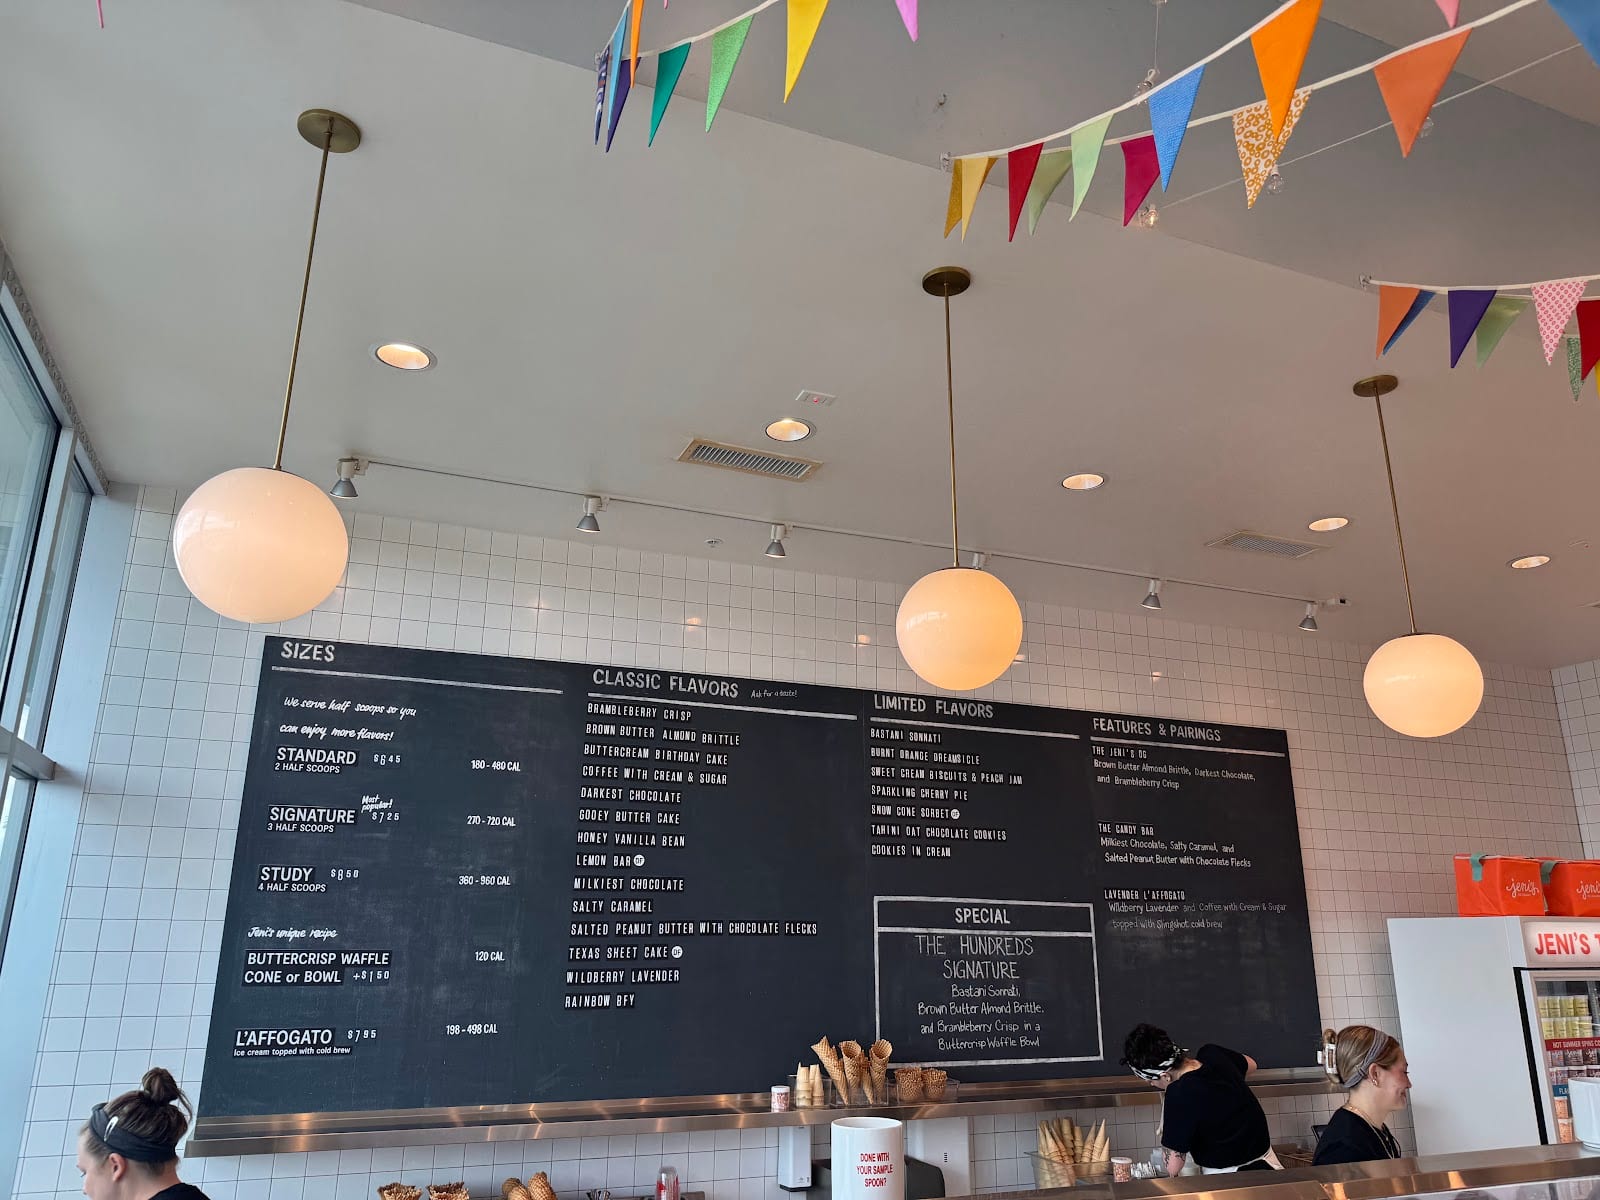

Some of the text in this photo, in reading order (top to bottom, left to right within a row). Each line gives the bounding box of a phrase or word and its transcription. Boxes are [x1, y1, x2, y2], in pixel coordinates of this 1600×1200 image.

[280, 642, 335, 662] SIZES
[592, 669, 739, 698] CLASSIC FLAVORS
[284, 697, 416, 720] We serve half scoops so you
[587, 703, 691, 721] BRAMBLEBERRY CRISP
[874, 694, 994, 719] LIMITED FLAVORS
[280, 723, 393, 741] can enjoy more flavors!
[585, 724, 740, 746] BROWN BUTTER ALMOND BRITTLE
[870, 728, 941, 743] BASTANI SONNATI
[1093, 717, 1221, 742] FEATURES & PAIRINGS
[277, 748, 357, 765] STANDARD
[584, 744, 728, 765] BUTTERCREAM BIRTHDAY CAKE
[871, 747, 980, 764] BURNT ORANGE DREAMSICLE
[1092, 746, 1147, 758] THE JENI'S OG
[275, 763, 340, 774] 2 HALF SCOOPS
[471, 760, 521, 772] 180 480 CAL
[582, 765, 727, 785] COFFEE WITH CREAM & SUGAR
[871, 767, 1022, 785] SWEET CREAM BISCUITS & PEACH JAM
[1097, 775, 1179, 790] and Brambleberry Crisp
[361, 794, 380, 804] Most
[581, 787, 681, 803] DARKEST CHOCOLATE
[871, 785, 968, 800] SPARKLING CHERRY PIE
[361, 799, 393, 813] popular!
[871, 804, 950, 819] SNOW CONE SORBET
[269, 807, 355, 823] SIGNATURE
[579, 809, 680, 824] GOOEY BUTTER CAKE
[871, 825, 1007, 841] TAHINI OAT CHOCOLATE COOKIES
[1098, 823, 1153, 836] THE CANDY BAR
[577, 832, 685, 847] HONEY VANILLA BEAN
[871, 844, 951, 857] COOKIES IN CREAM
[576, 854, 631, 867] LEMON BAR
[261, 867, 313, 882] STUDY
[574, 878, 684, 891] MILKIEST CHOCOLATE
[1104, 890, 1185, 900] LAVENDER L'AFFOGATO
[955, 908, 1010, 924] SPECIAL
[247, 926, 338, 942] Jeni's unique recipe
[571, 923, 817, 935] SALTED PEANUT BUTTER WITH CHOCOLATE FLECKS
[915, 935, 1033, 956] THE HUNDREDS
[1535, 932, 1591, 955] JENI'S
[247, 953, 389, 965] BUTTERCRISP WAFFLE
[475, 951, 505, 961] 120 CAL
[569, 946, 668, 960] TEXAS SHEET CAKE
[245, 970, 341, 983] CONE or BOWL
[566, 970, 680, 983] WILDBERRY LAVENDER
[943, 959, 1020, 980] SIGNATURE
[565, 994, 635, 1007] RAINBOW BFY
[918, 1002, 947, 1015] Brown
[949, 1003, 979, 1015] Butter
[981, 1003, 1011, 1014] Almond
[921, 1023, 933, 1034] and
[937, 1021, 992, 1033] Brambleberry
[995, 1020, 1019, 1032] Crisp
[1024, 1020, 1032, 1031] in
[236, 1030, 332, 1046] L'AFFOGATO
[938, 1035, 1040, 1050] Buttercrisp Waffle Bowl
[272, 1048, 297, 1057] topped
[299, 1047, 314, 1055] with
[316, 1047, 331, 1055] cold
[860, 1152, 889, 1163] DONE WITH
[856, 1164, 893, 1175] YOUR SAMPLE
[864, 1177, 887, 1187] SPOON?
